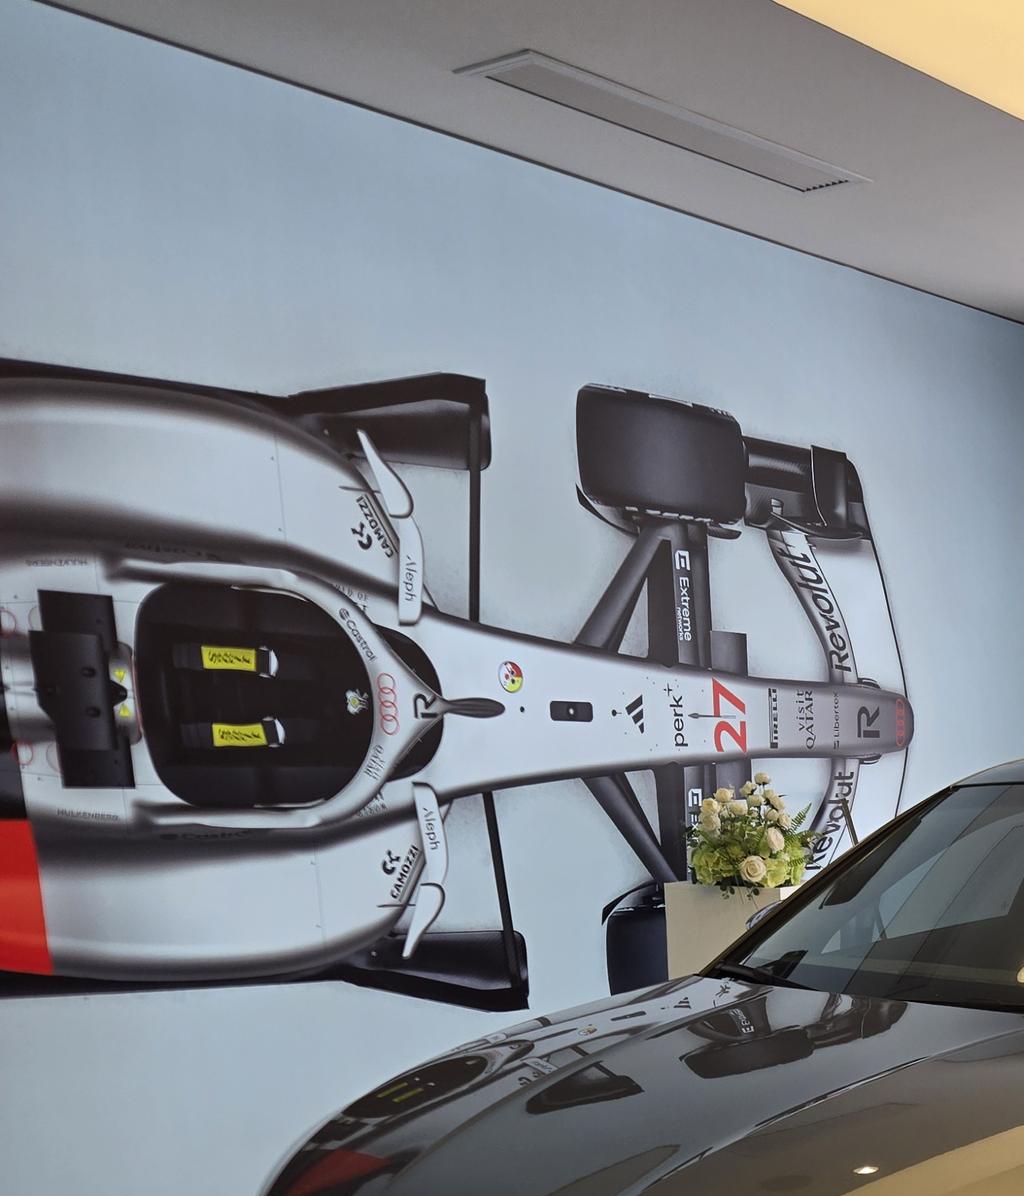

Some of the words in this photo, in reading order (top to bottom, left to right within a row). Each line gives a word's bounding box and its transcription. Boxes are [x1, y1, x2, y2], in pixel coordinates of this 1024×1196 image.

[356, 495, 394, 558] CAMOZZI
[674, 606, 684, 642] networks
[679, 576, 692, 642] Extreme
[778, 547, 852, 672] Revolut
[712, 676, 747, 754] 27
[796, 690, 805, 731] visit
[804, 690, 816, 749] QATAR
[390, 844, 419, 899] CAMOZZI
